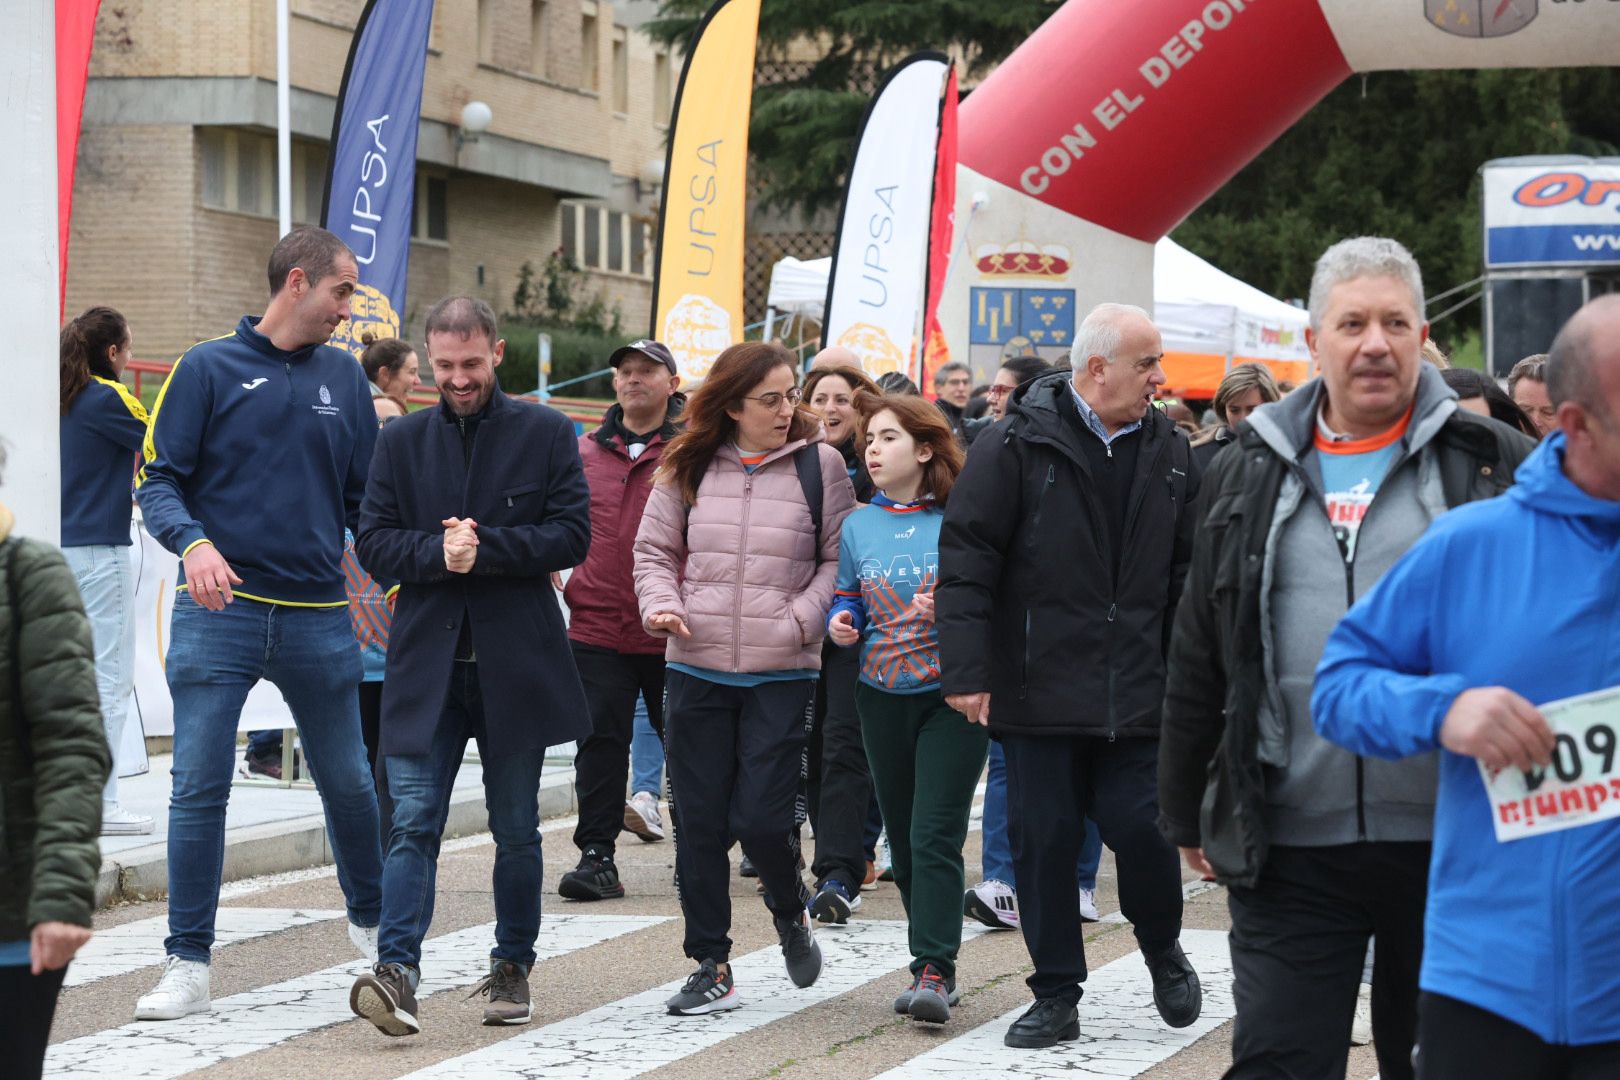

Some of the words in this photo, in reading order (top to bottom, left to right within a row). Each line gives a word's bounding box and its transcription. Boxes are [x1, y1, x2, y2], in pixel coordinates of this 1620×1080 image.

[350, 114, 389, 265] UPSA
[1020, 123, 1097, 195] CON
[1091, 88, 1145, 131] EL
[1513, 173, 1620, 213] Or
[687, 139, 723, 276] UPSA
[859, 185, 899, 308] UPSA
